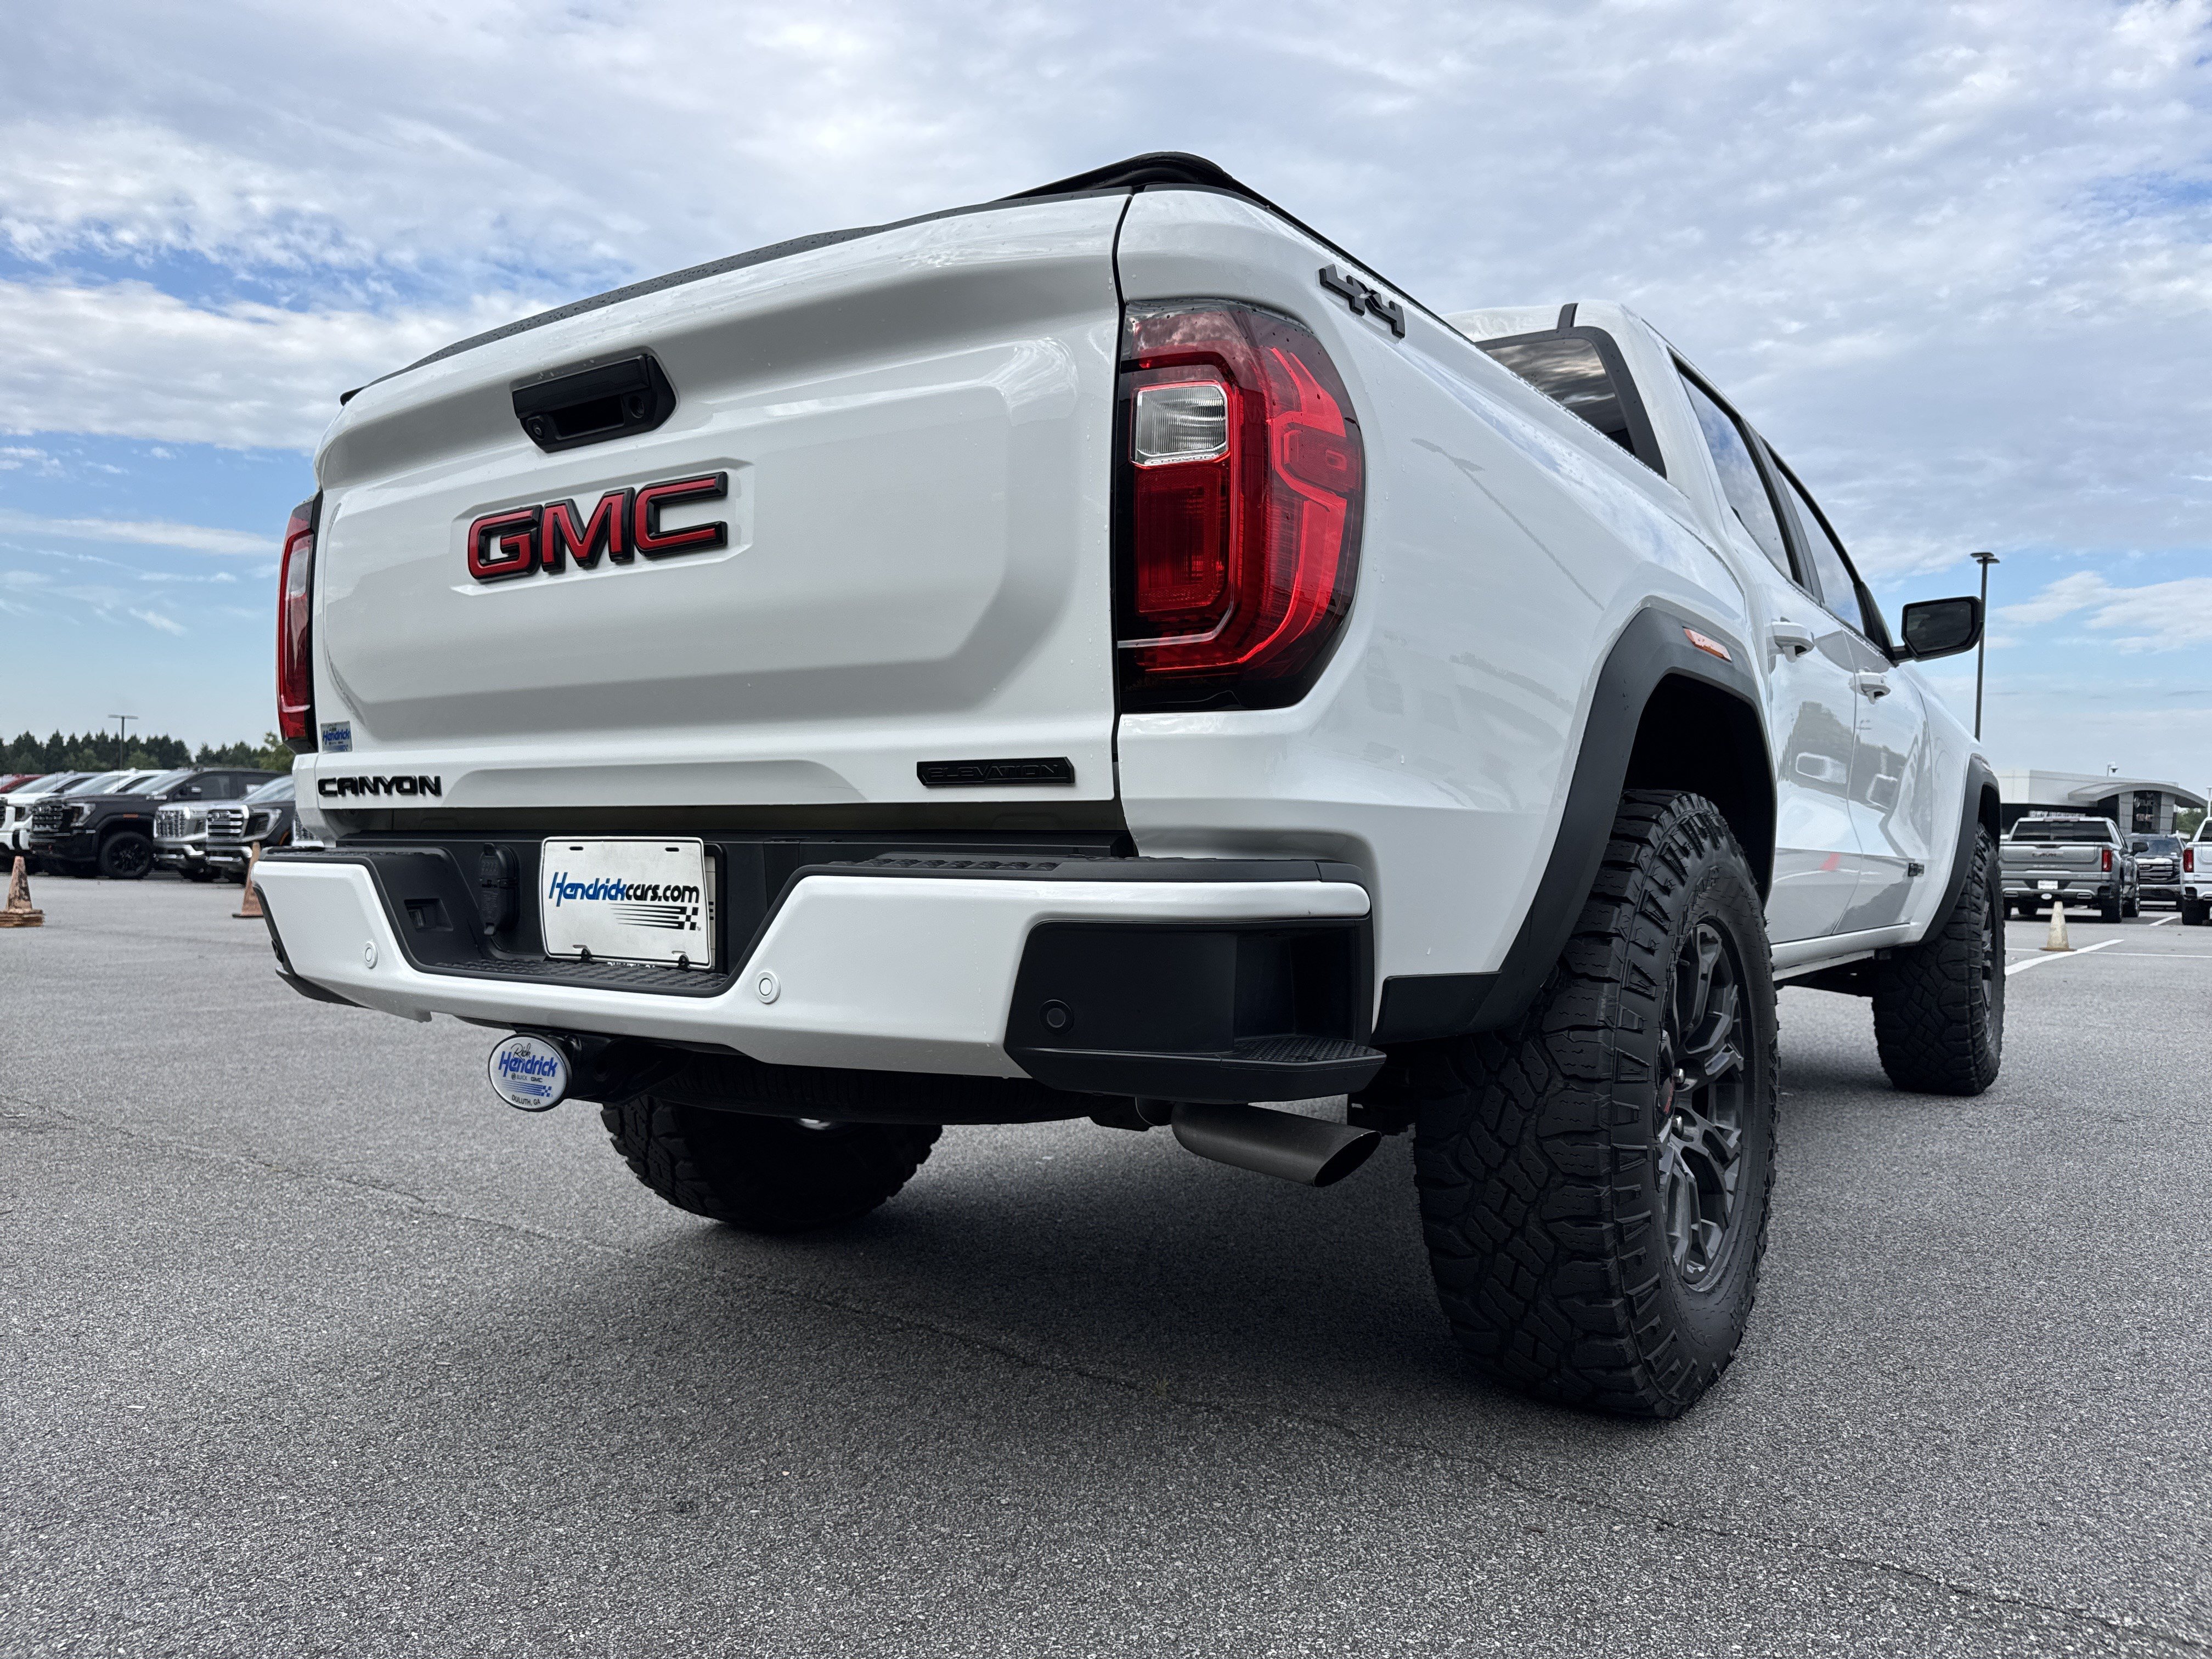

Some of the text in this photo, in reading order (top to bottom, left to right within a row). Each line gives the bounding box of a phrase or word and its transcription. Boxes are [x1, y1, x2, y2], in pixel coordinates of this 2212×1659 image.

[468, 471, 729, 583] GMC
[927, 764, 1059, 778] ELEVATION
[318, 775, 442, 797] CANYON
[549, 872, 699, 907] Hendrickcars.com
[498, 1051, 558, 1077] Hendrick
[511, 1094, 533, 1106] DULUTH,
